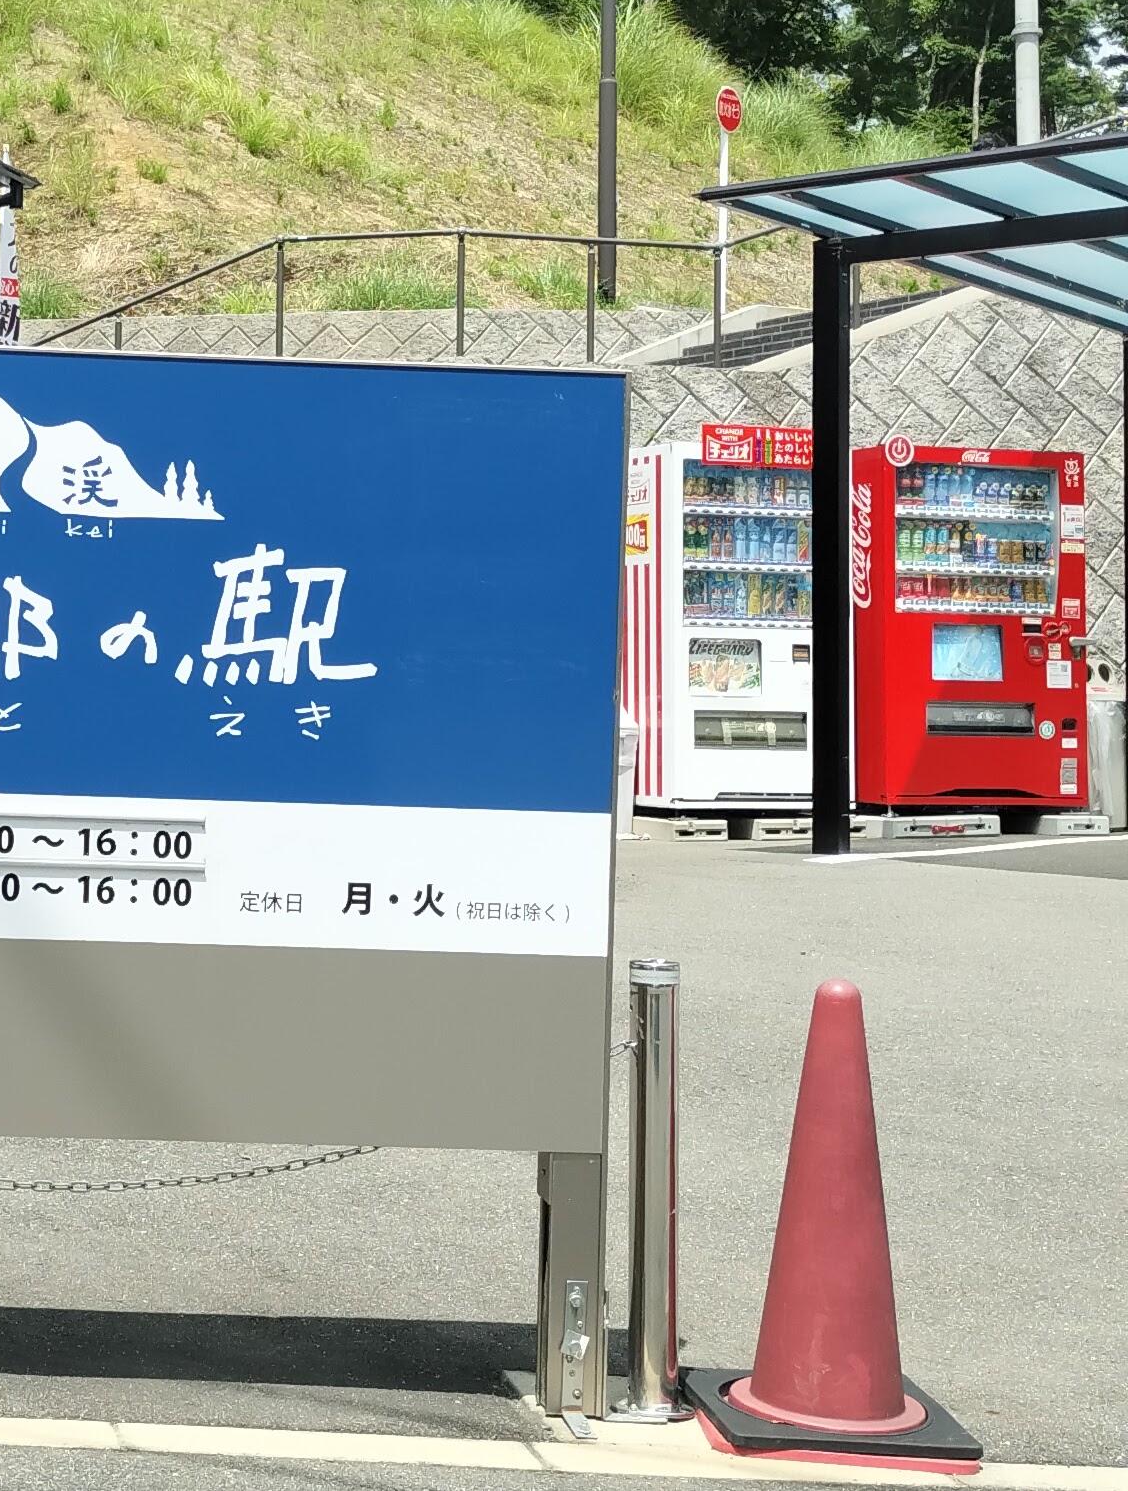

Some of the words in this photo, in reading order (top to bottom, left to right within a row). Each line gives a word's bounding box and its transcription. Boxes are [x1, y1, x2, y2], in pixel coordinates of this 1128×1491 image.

[709, 440, 750, 460] チェリオ
[65, 519, 113, 539] kei
[209, 695, 332, 741] えき
[239, 890, 303, 914] 定休日
